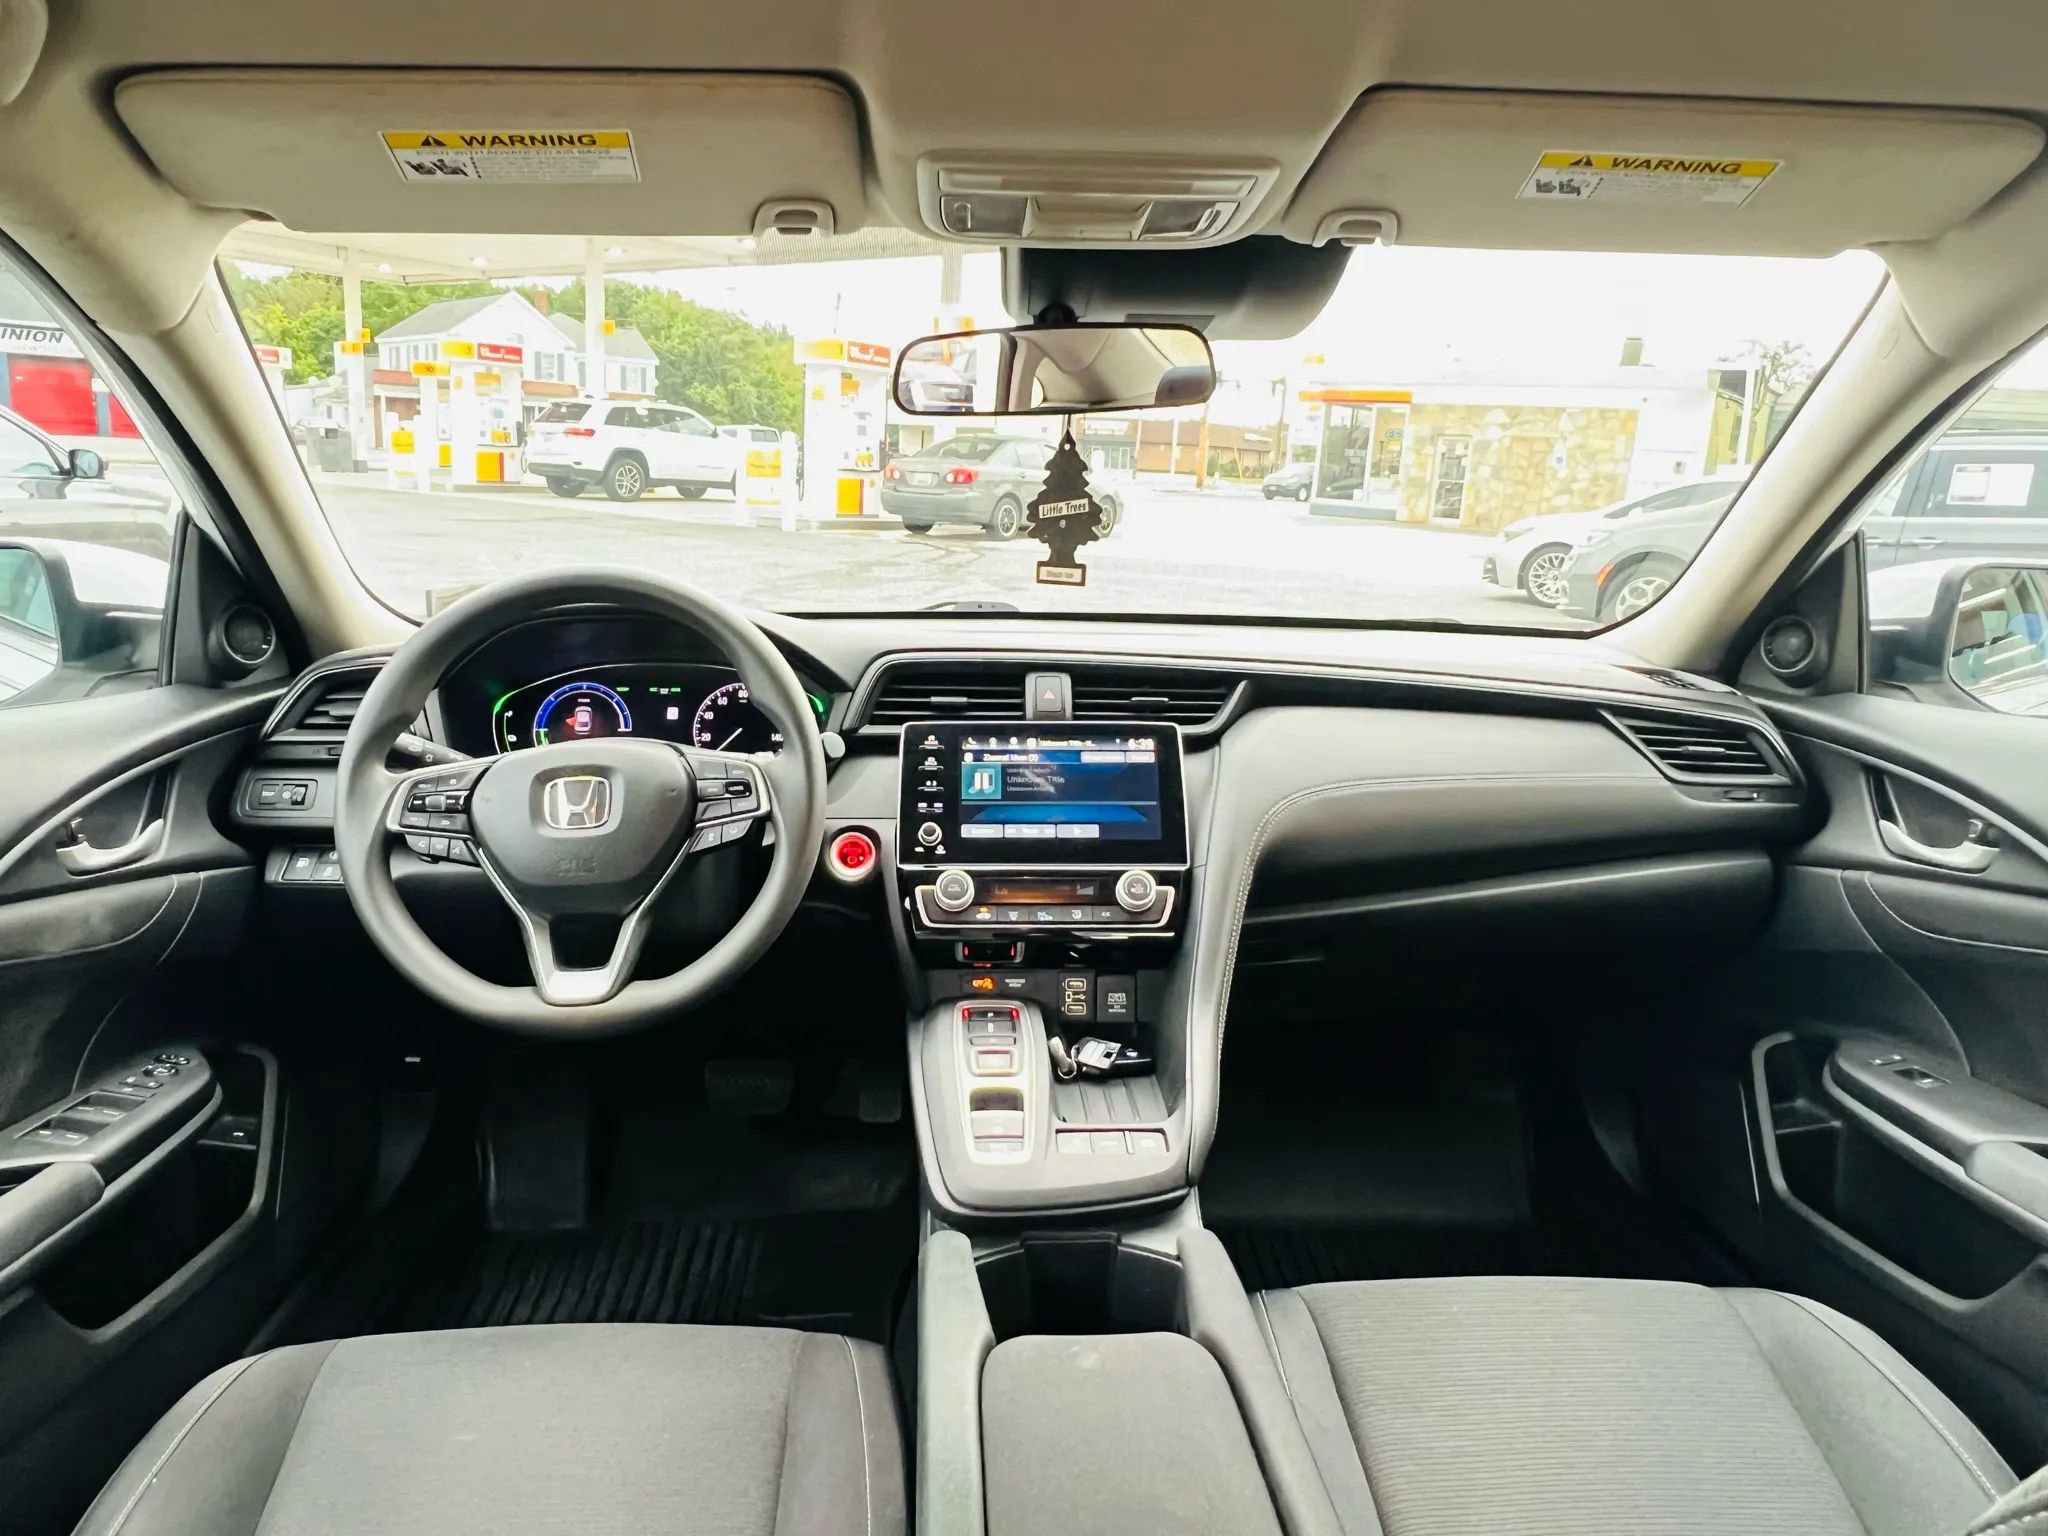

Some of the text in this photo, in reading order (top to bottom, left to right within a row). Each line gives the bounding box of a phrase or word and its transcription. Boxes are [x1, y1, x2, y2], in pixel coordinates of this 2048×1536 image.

[460, 134, 597, 147] WARNING
[1611, 156, 1742, 174] WARNING
[0, 327, 64, 343] INION
[1042, 502, 1086, 517] Little Trees
[738, 690, 748, 698] 80
[717, 697, 728, 705] 60
[703, 712, 714, 720] 40
[701, 733, 711, 742] 20
